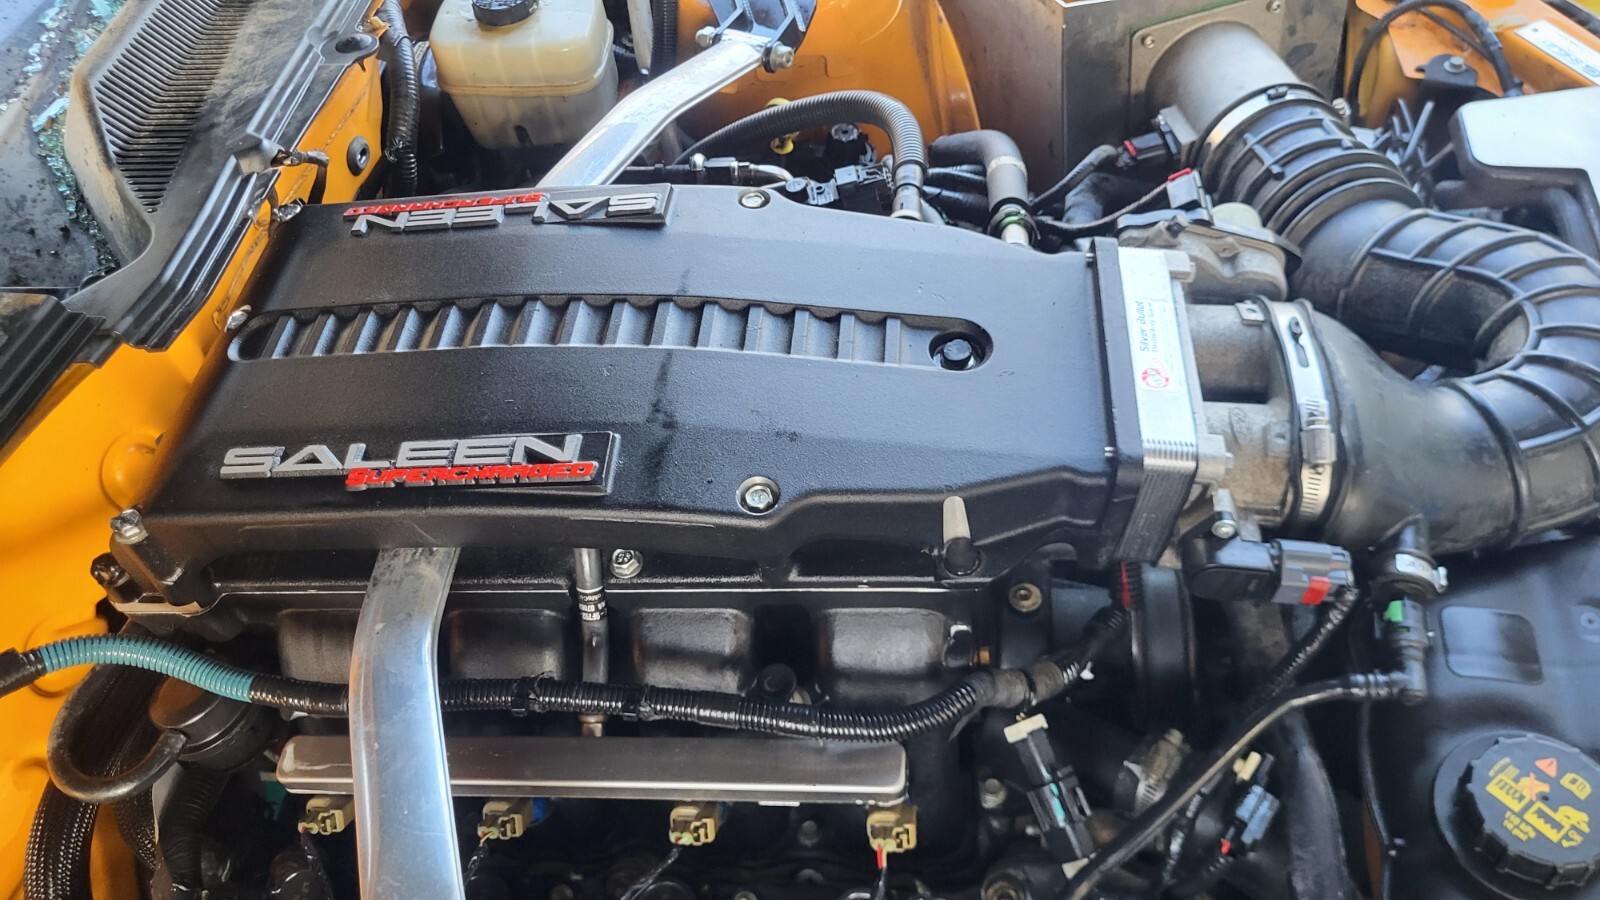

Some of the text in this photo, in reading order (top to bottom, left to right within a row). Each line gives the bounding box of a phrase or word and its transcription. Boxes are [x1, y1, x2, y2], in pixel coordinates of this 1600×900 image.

[351, 192, 662, 236] SALEEN
[220, 433, 583, 478] SALEEN
[345, 461, 598, 491] SUPERCHARGED
